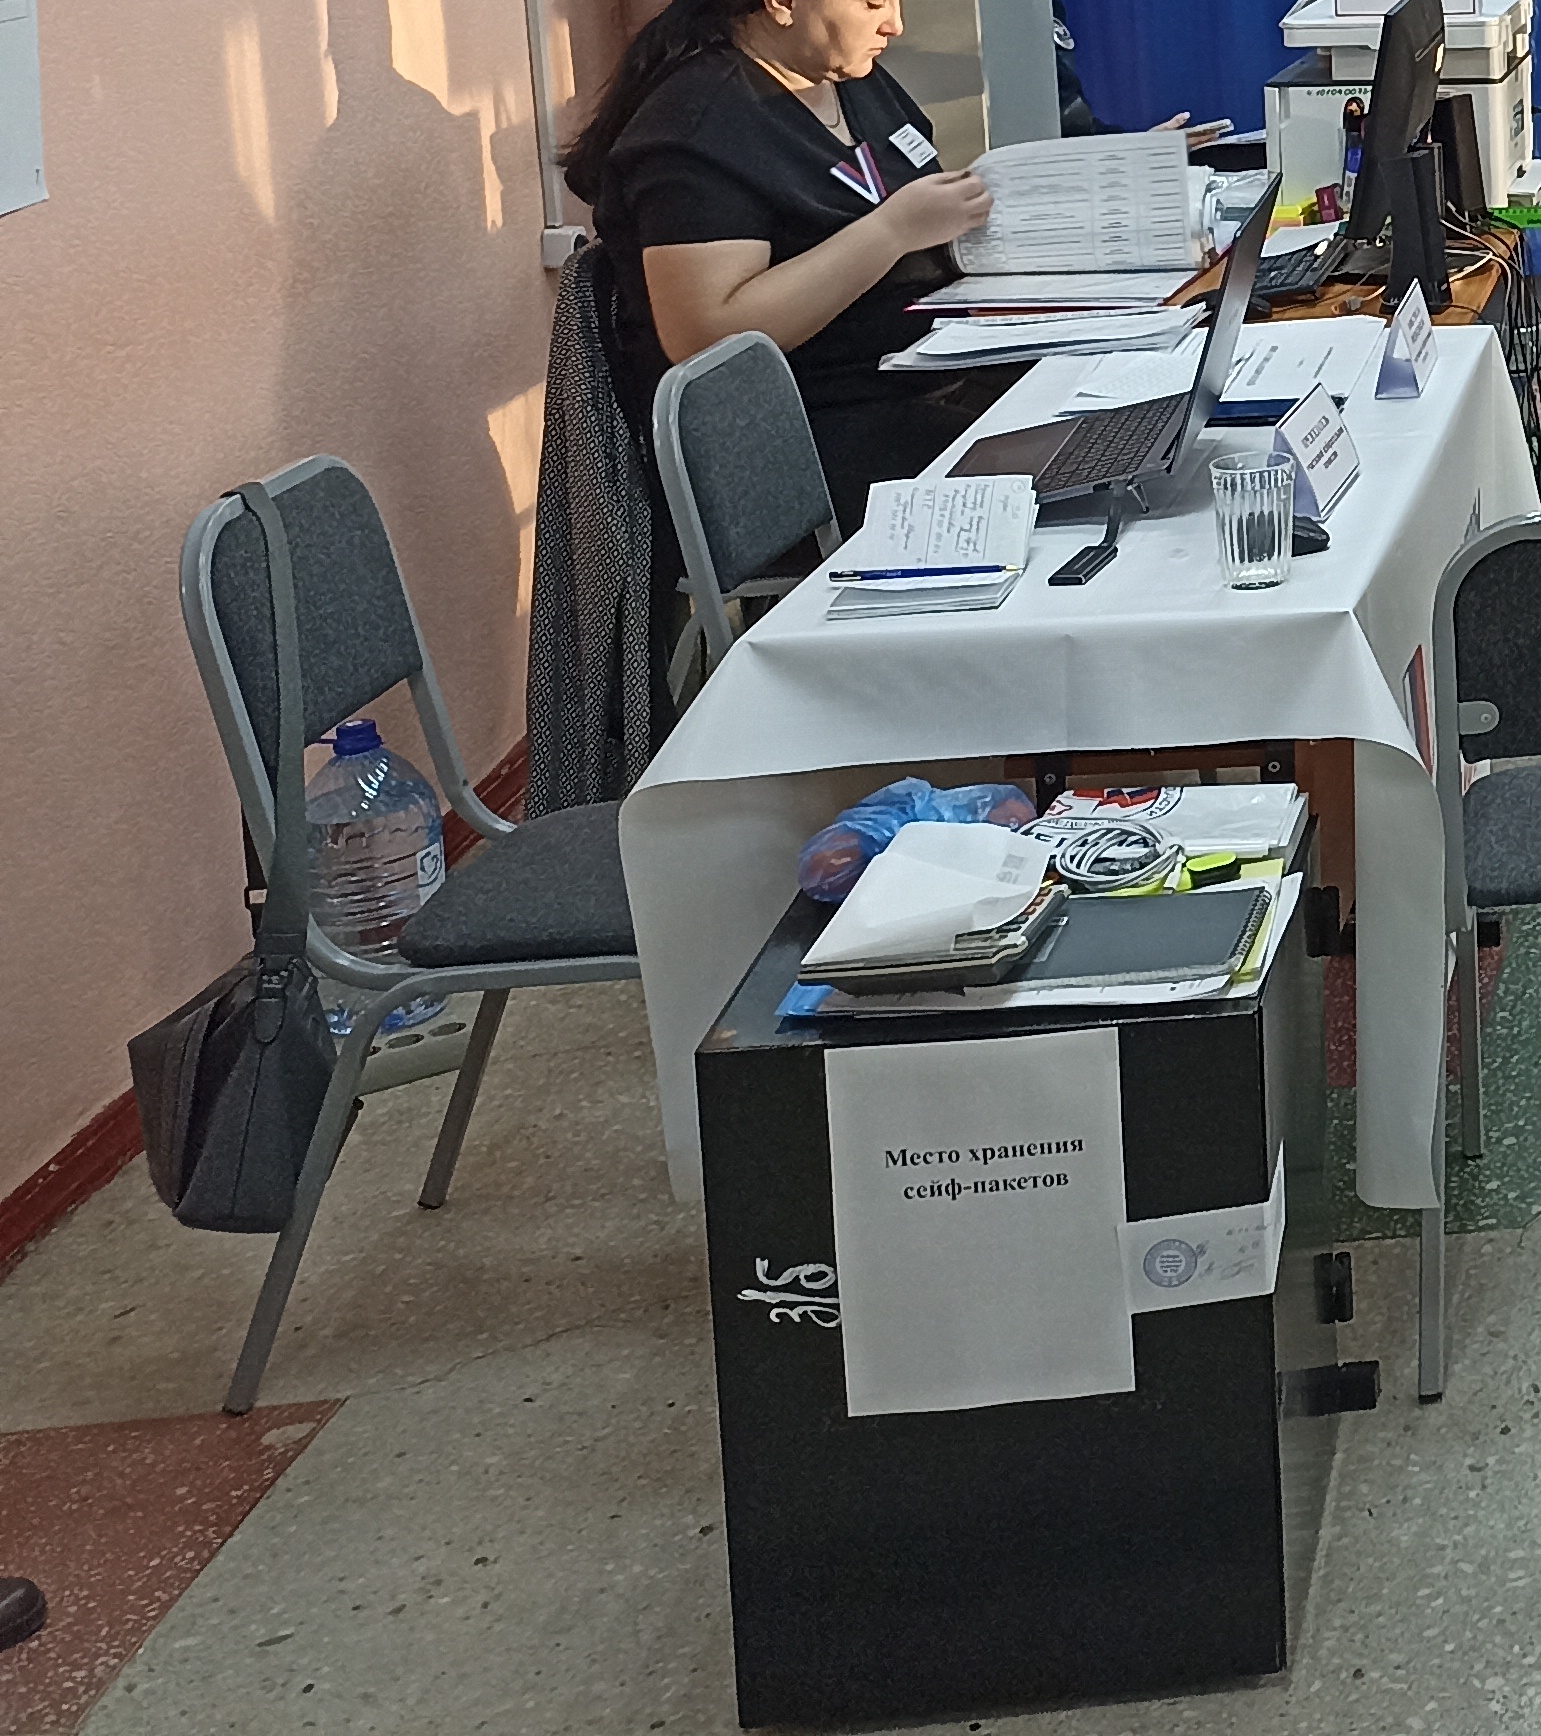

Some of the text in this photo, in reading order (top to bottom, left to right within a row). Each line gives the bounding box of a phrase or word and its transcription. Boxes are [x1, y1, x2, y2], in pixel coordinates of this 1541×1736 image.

[885, 1138, 1084, 1168] Место хранения
[903, 1172, 1069, 1201] сейф-пакетов
